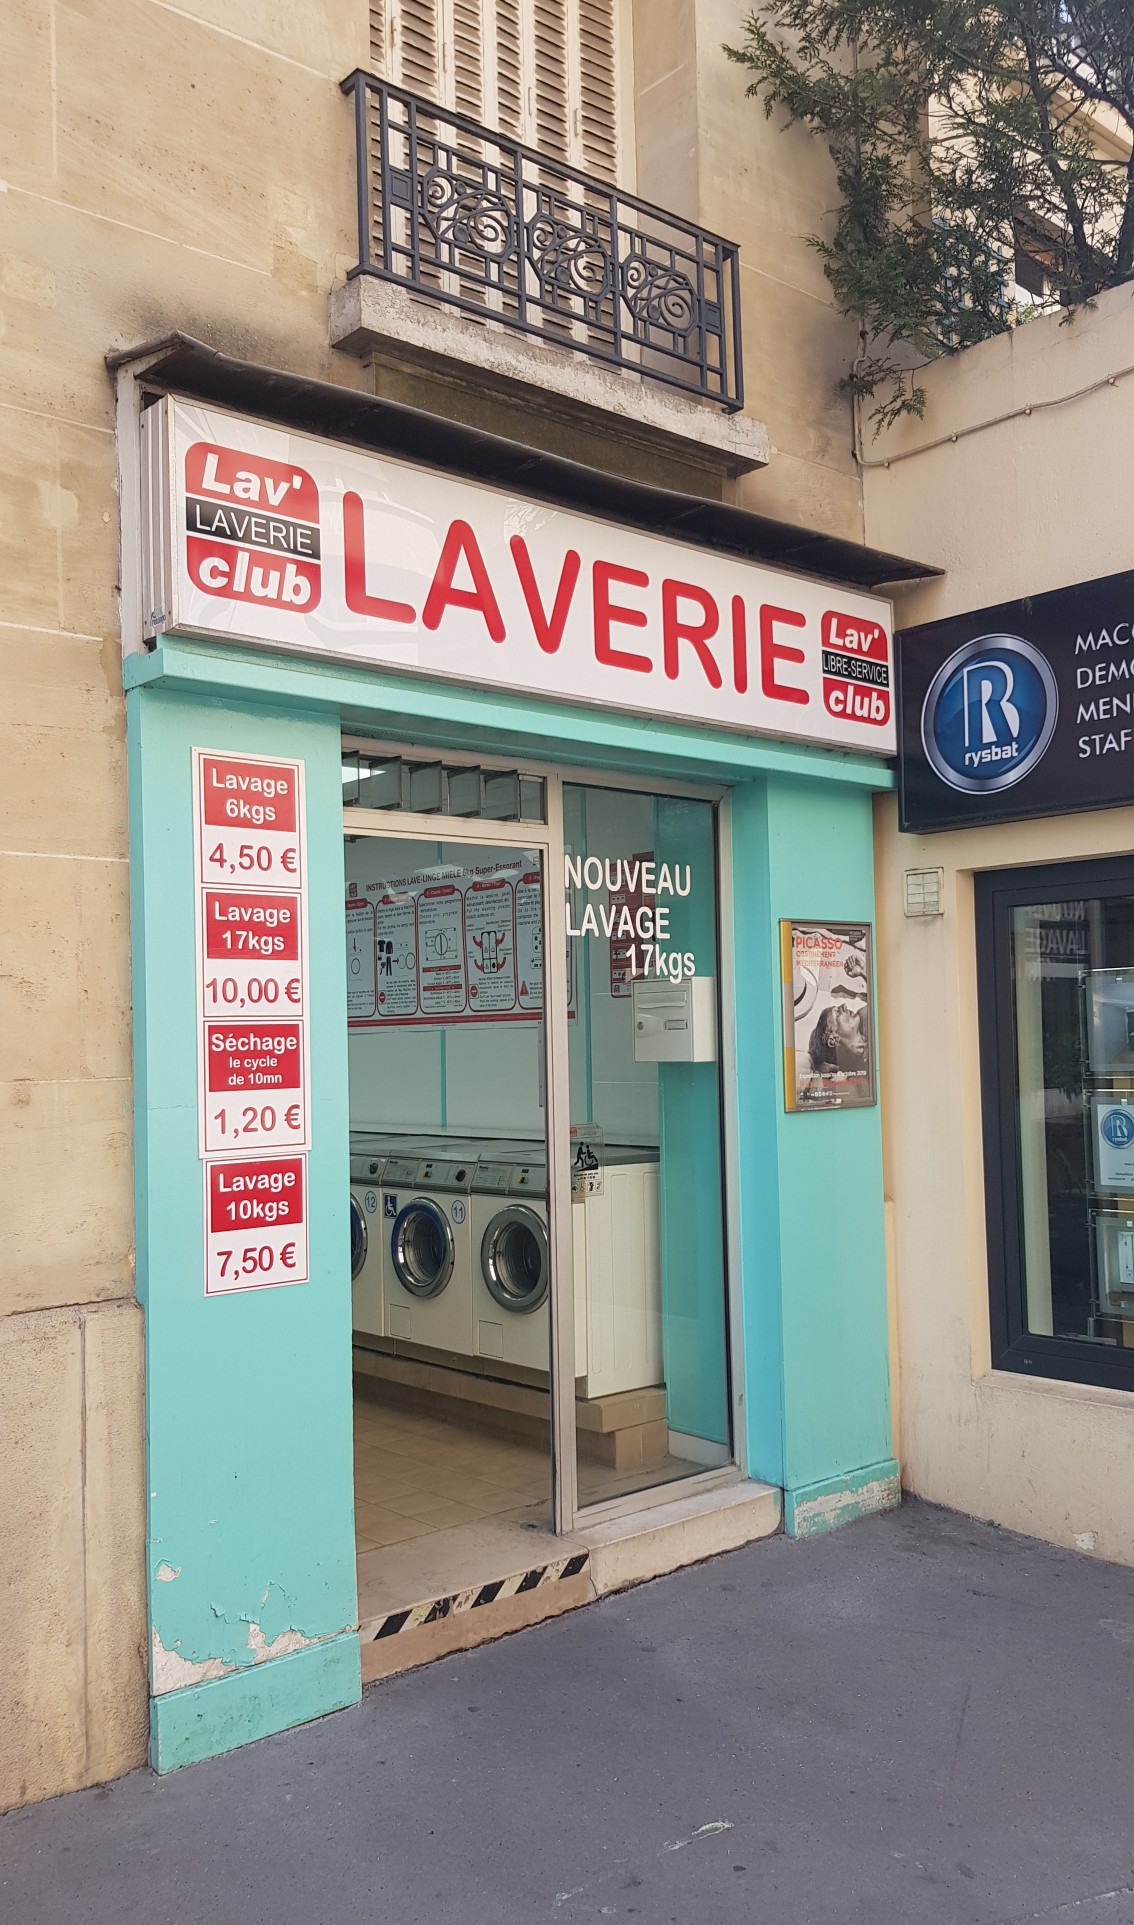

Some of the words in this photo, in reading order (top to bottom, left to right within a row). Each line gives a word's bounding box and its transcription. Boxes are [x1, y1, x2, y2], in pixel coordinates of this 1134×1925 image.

[201, 453, 303, 507] Lav'
[195, 504, 313, 554] LAVERIE
[199, 551, 312, 606] club
[343, 490, 810, 705] LAVERIE
[829, 617, 879, 652] Lav'
[1075, 622, 1134, 654] MAC
[822, 654, 888, 684] LIBRE-SERVICE
[1076, 658, 1134, 689] DEM
[829, 685, 885, 721] club
[1077, 692, 1134, 724] MEN
[964, 741, 1019, 767] rysbat
[212, 767, 289, 798] Lavage
[226, 798, 276, 824] 6kgs
[209, 842, 273, 874] 4,50
[280, 847, 297, 873] €
[366, 878, 407, 891] INSTRUCTIONS
[441, 869, 461, 880] MIELE
[564, 854, 691, 897] NOUVEAU
[214, 901, 291, 928] Lavage
[565, 902, 671, 940] LAVAGE
[222, 930, 285, 955] 17kgs
[795, 935, 843, 950] PICASSO
[626, 943, 696, 984] 17kgs
[205, 977, 280, 1008] 10,00
[284, 978, 301, 1003] €
[211, 1033, 297, 1055] Séchage
[229, 1056, 241, 1068] le
[243, 1055, 278, 1070] cycle
[228, 1073, 245, 1085] de
[248, 1072, 283, 1085] 10mn
[214, 1105, 277, 1139] 1,20
[284, 1104, 301, 1130] €
[219, 1171, 296, 1193] Lavage
[226, 1198, 290, 1222] 10kgs
[366, 1196, 376, 1208] 12
[453, 1206, 463, 1218] 11
[216, 1245, 275, 1281] 7,50
[279, 1242, 297, 1268] €
